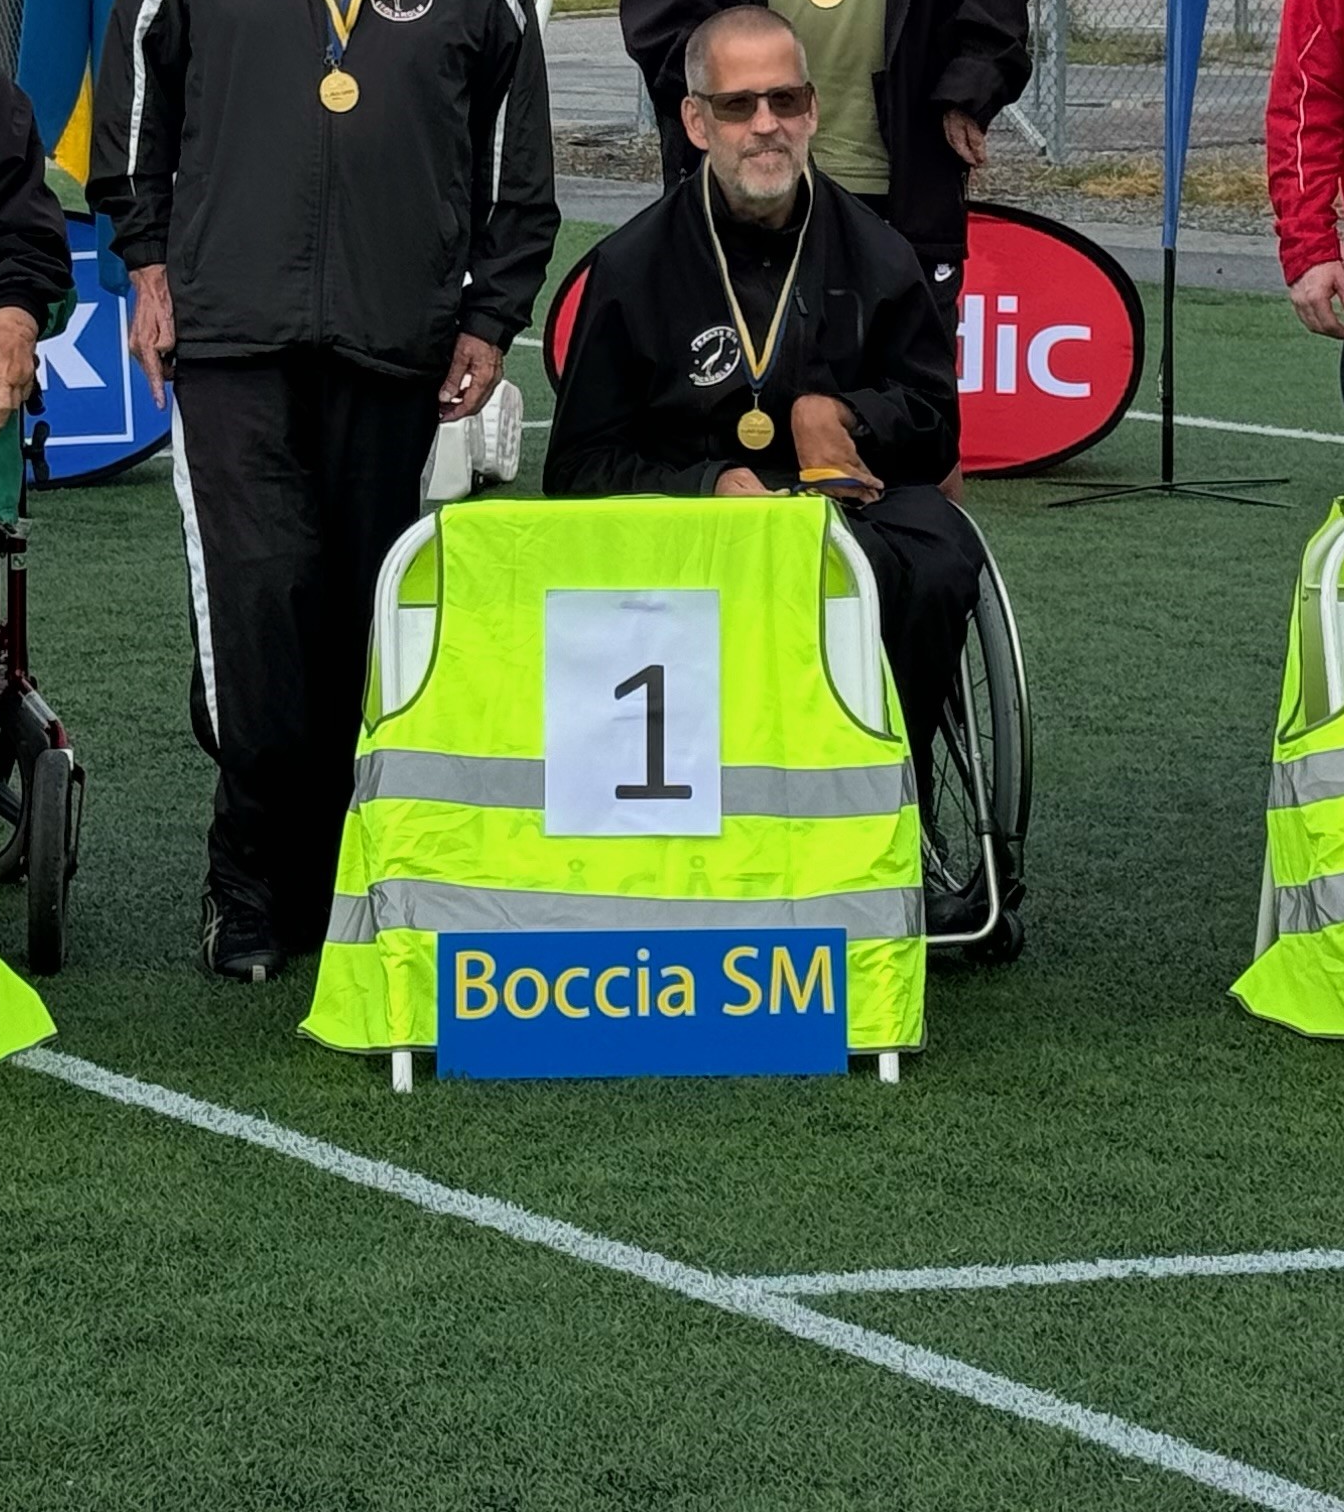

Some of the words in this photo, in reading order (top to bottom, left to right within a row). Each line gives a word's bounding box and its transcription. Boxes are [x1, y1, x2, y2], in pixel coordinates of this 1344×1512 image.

[956, 294, 1092, 399] dic
[613, 663, 694, 800] 1
[454, 947, 697, 1020] Boccia
[721, 945, 836, 1017] SM
